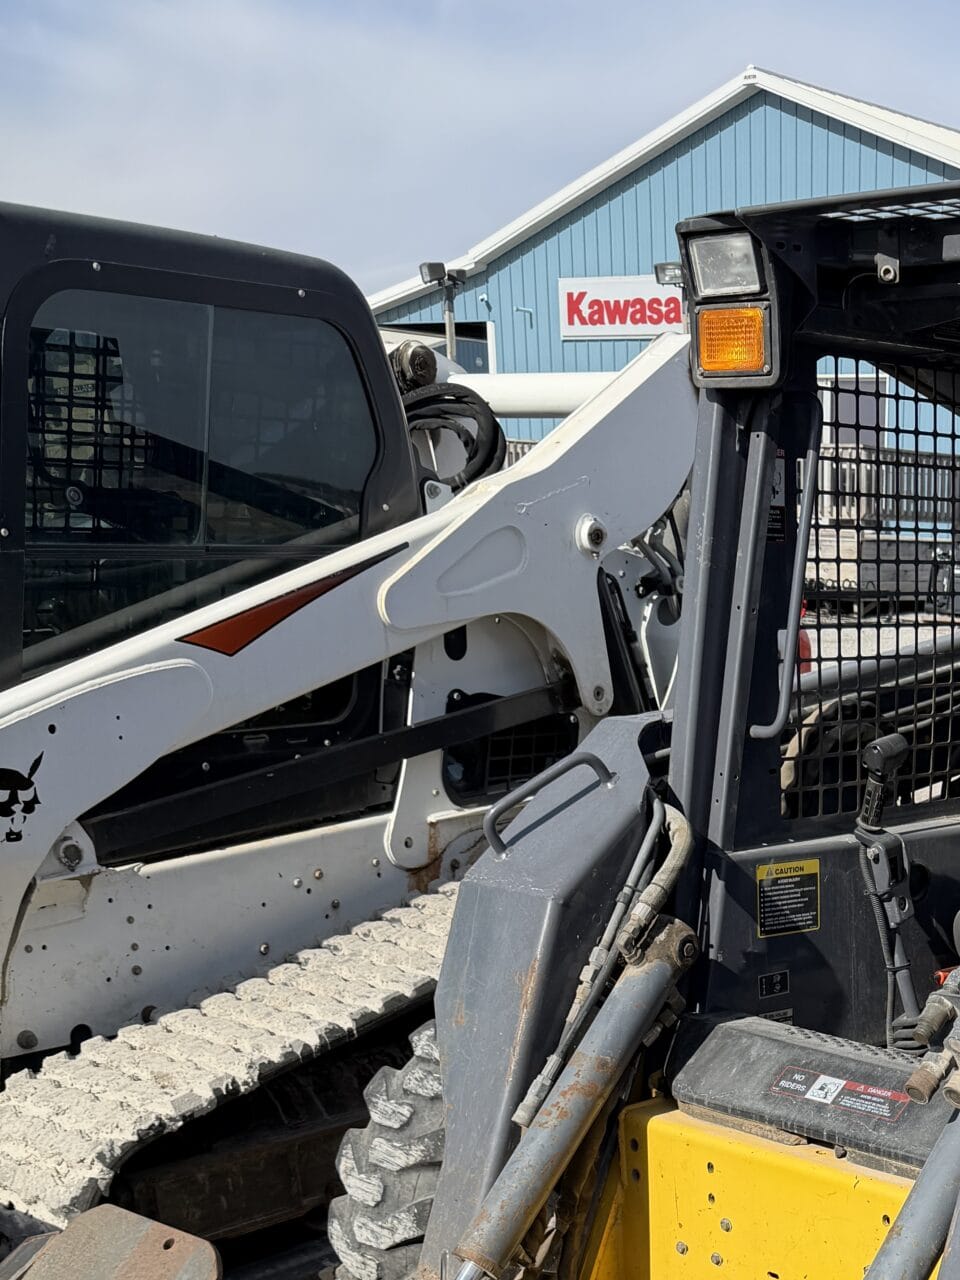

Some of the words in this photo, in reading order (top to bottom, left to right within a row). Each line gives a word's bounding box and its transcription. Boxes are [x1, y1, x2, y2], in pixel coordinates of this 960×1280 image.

[566, 291, 682, 326] Kawasa
[774, 866, 805, 876] CAUTION
[792, 1073, 805, 1082] NO
[779, 1080, 807, 1092] RIDERS
